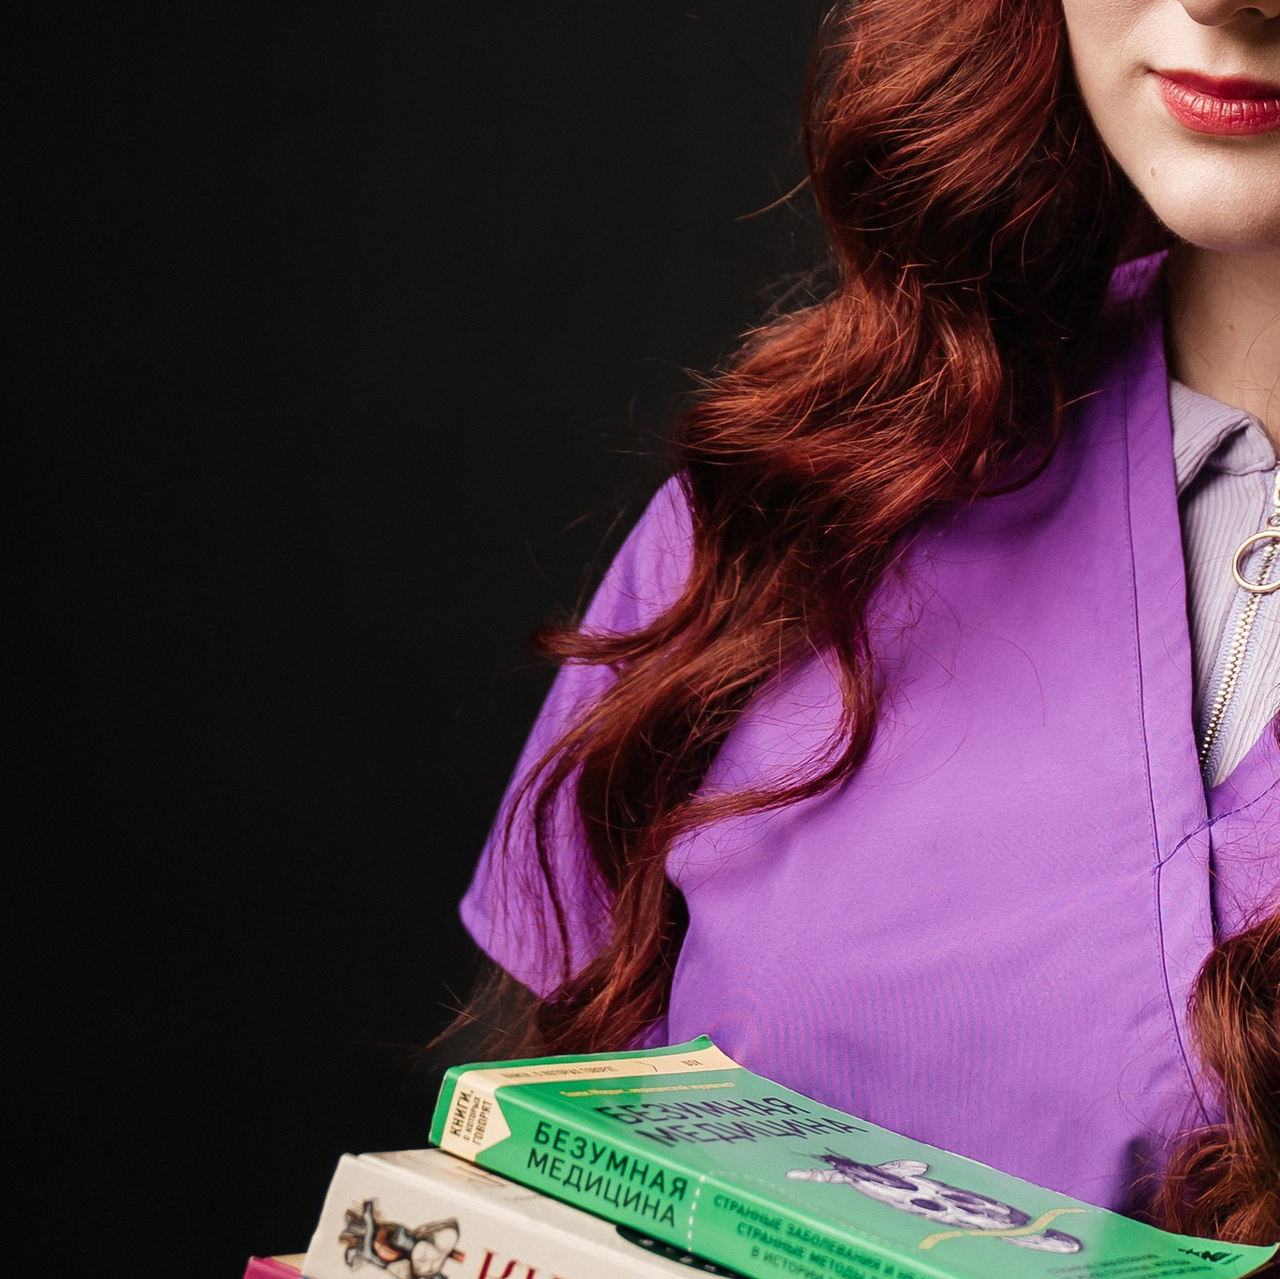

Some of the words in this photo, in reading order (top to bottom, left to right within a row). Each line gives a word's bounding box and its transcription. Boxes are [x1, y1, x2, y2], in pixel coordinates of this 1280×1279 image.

[466, 1096, 482, 1131] КОТОРЫХ
[471, 1100, 493, 1146] ГОВОРЯТ
[592, 1096, 812, 1125] БЕЗУМНАЯ
[634, 1116, 869, 1148] МЕДИЦИНА
[534, 1121, 688, 1201] БЕЗУМНАЯ
[527, 1148, 675, 1227] МЕДИЦИНА
[713, 1191, 784, 1233] СТРАННЫЕ
[785, 1222, 882, 1270] ЗАБОЛЕВАНИЯ
[736, 1221, 805, 1258] СТРАННЫЕ
[751, 1244, 761, 1258] В
